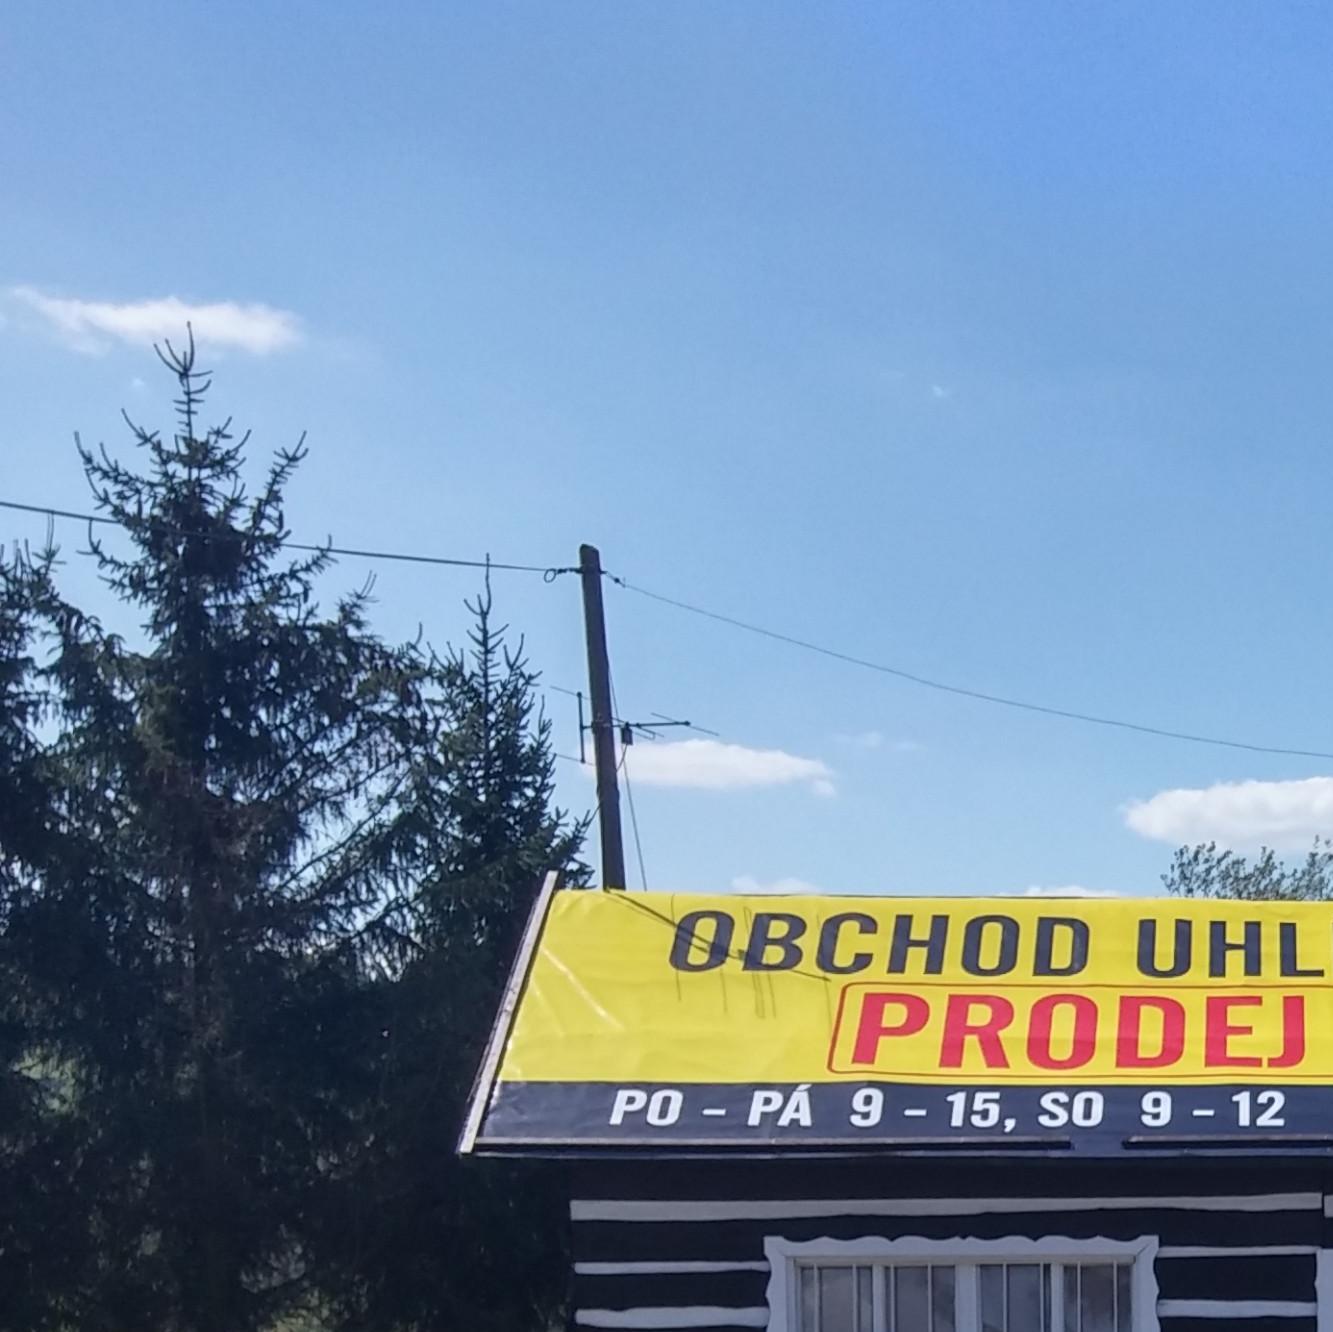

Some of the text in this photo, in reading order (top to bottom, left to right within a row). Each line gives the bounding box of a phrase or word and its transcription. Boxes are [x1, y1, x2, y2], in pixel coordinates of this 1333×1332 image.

[668, 909, 1092, 977] OBCHOD
[850, 992, 1306, 1069] PRODEJ
[609, 1088, 684, 1127] PO
[747, 1083, 813, 1127] PÁ
[849, 1086, 885, 1128] 9
[945, 1090, 1017, 1134] 15,
[1037, 1090, 1105, 1128] SO
[1140, 1090, 1172, 1128] 9
[1230, 1090, 1286, 1127] 12
